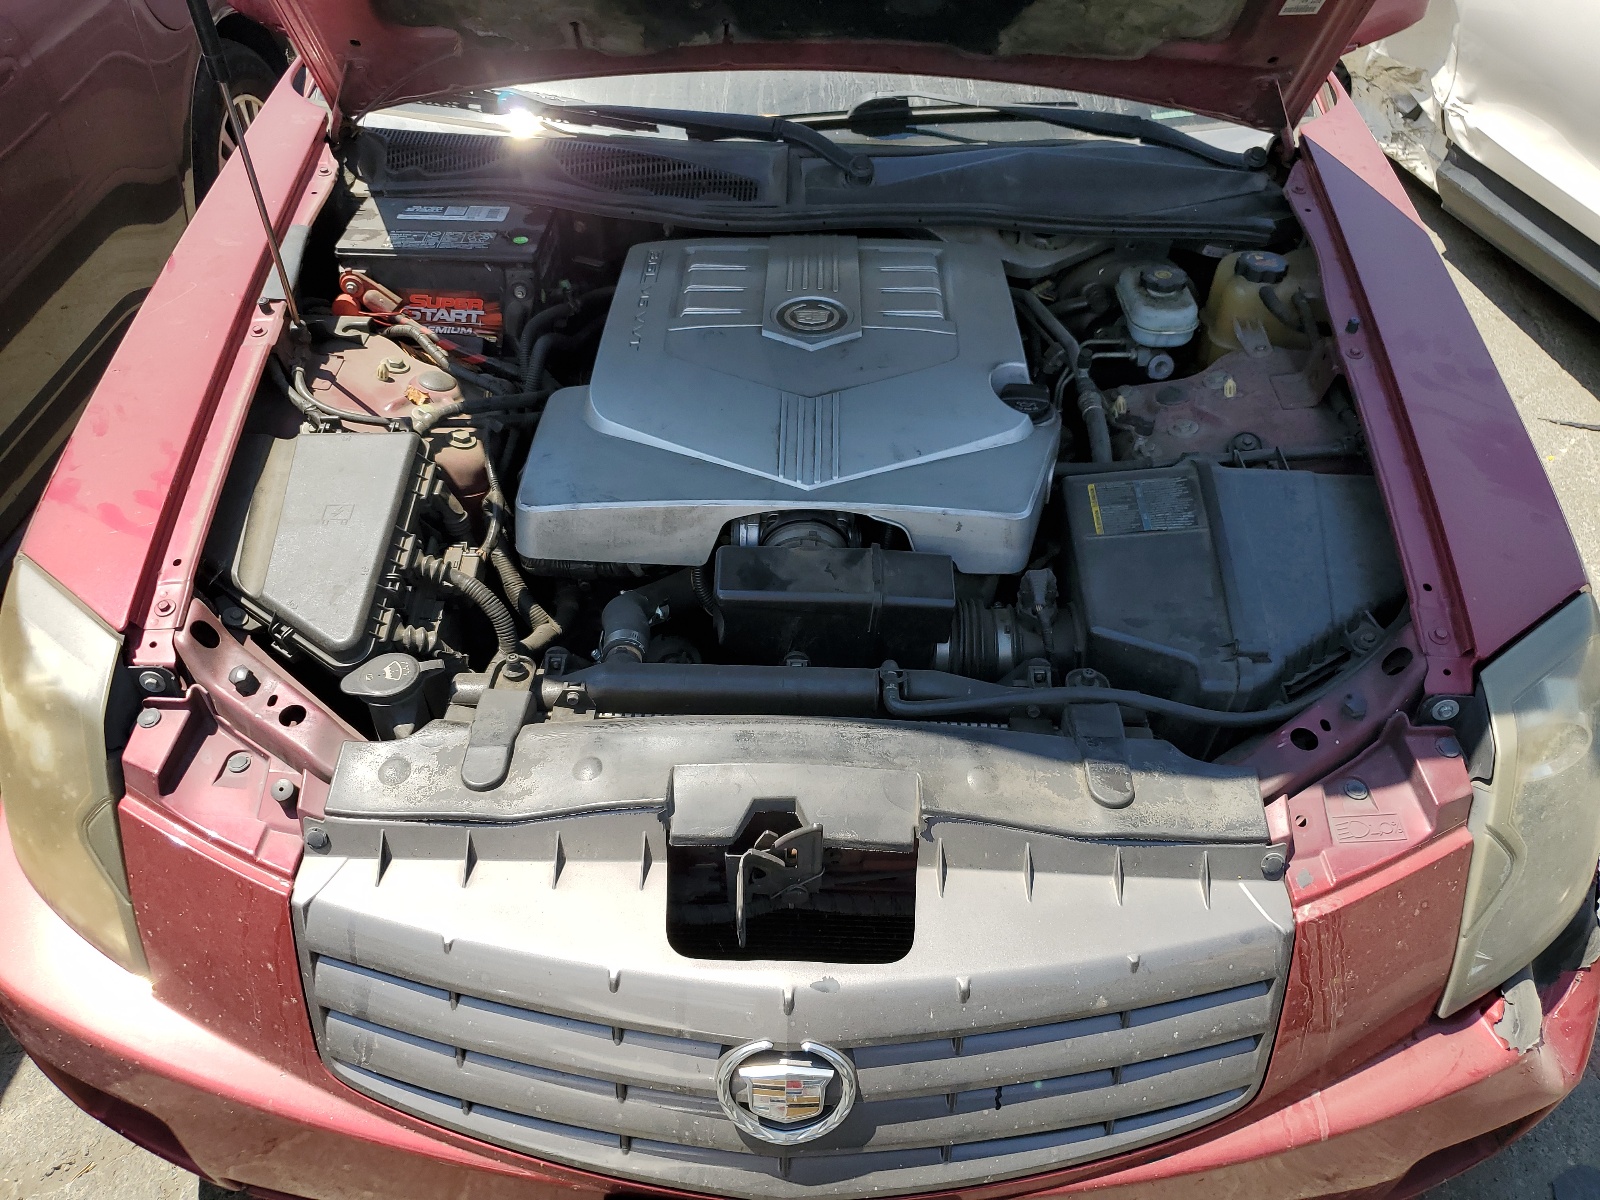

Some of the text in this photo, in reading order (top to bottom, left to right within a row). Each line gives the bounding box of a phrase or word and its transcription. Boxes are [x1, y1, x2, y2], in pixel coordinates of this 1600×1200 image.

[409, 294, 484, 310] SUPER
[638, 286, 652, 308] V6
[404, 306, 485, 323] START
[427, 325, 473, 335] EMIUM
[629, 311, 646, 352] VVT
